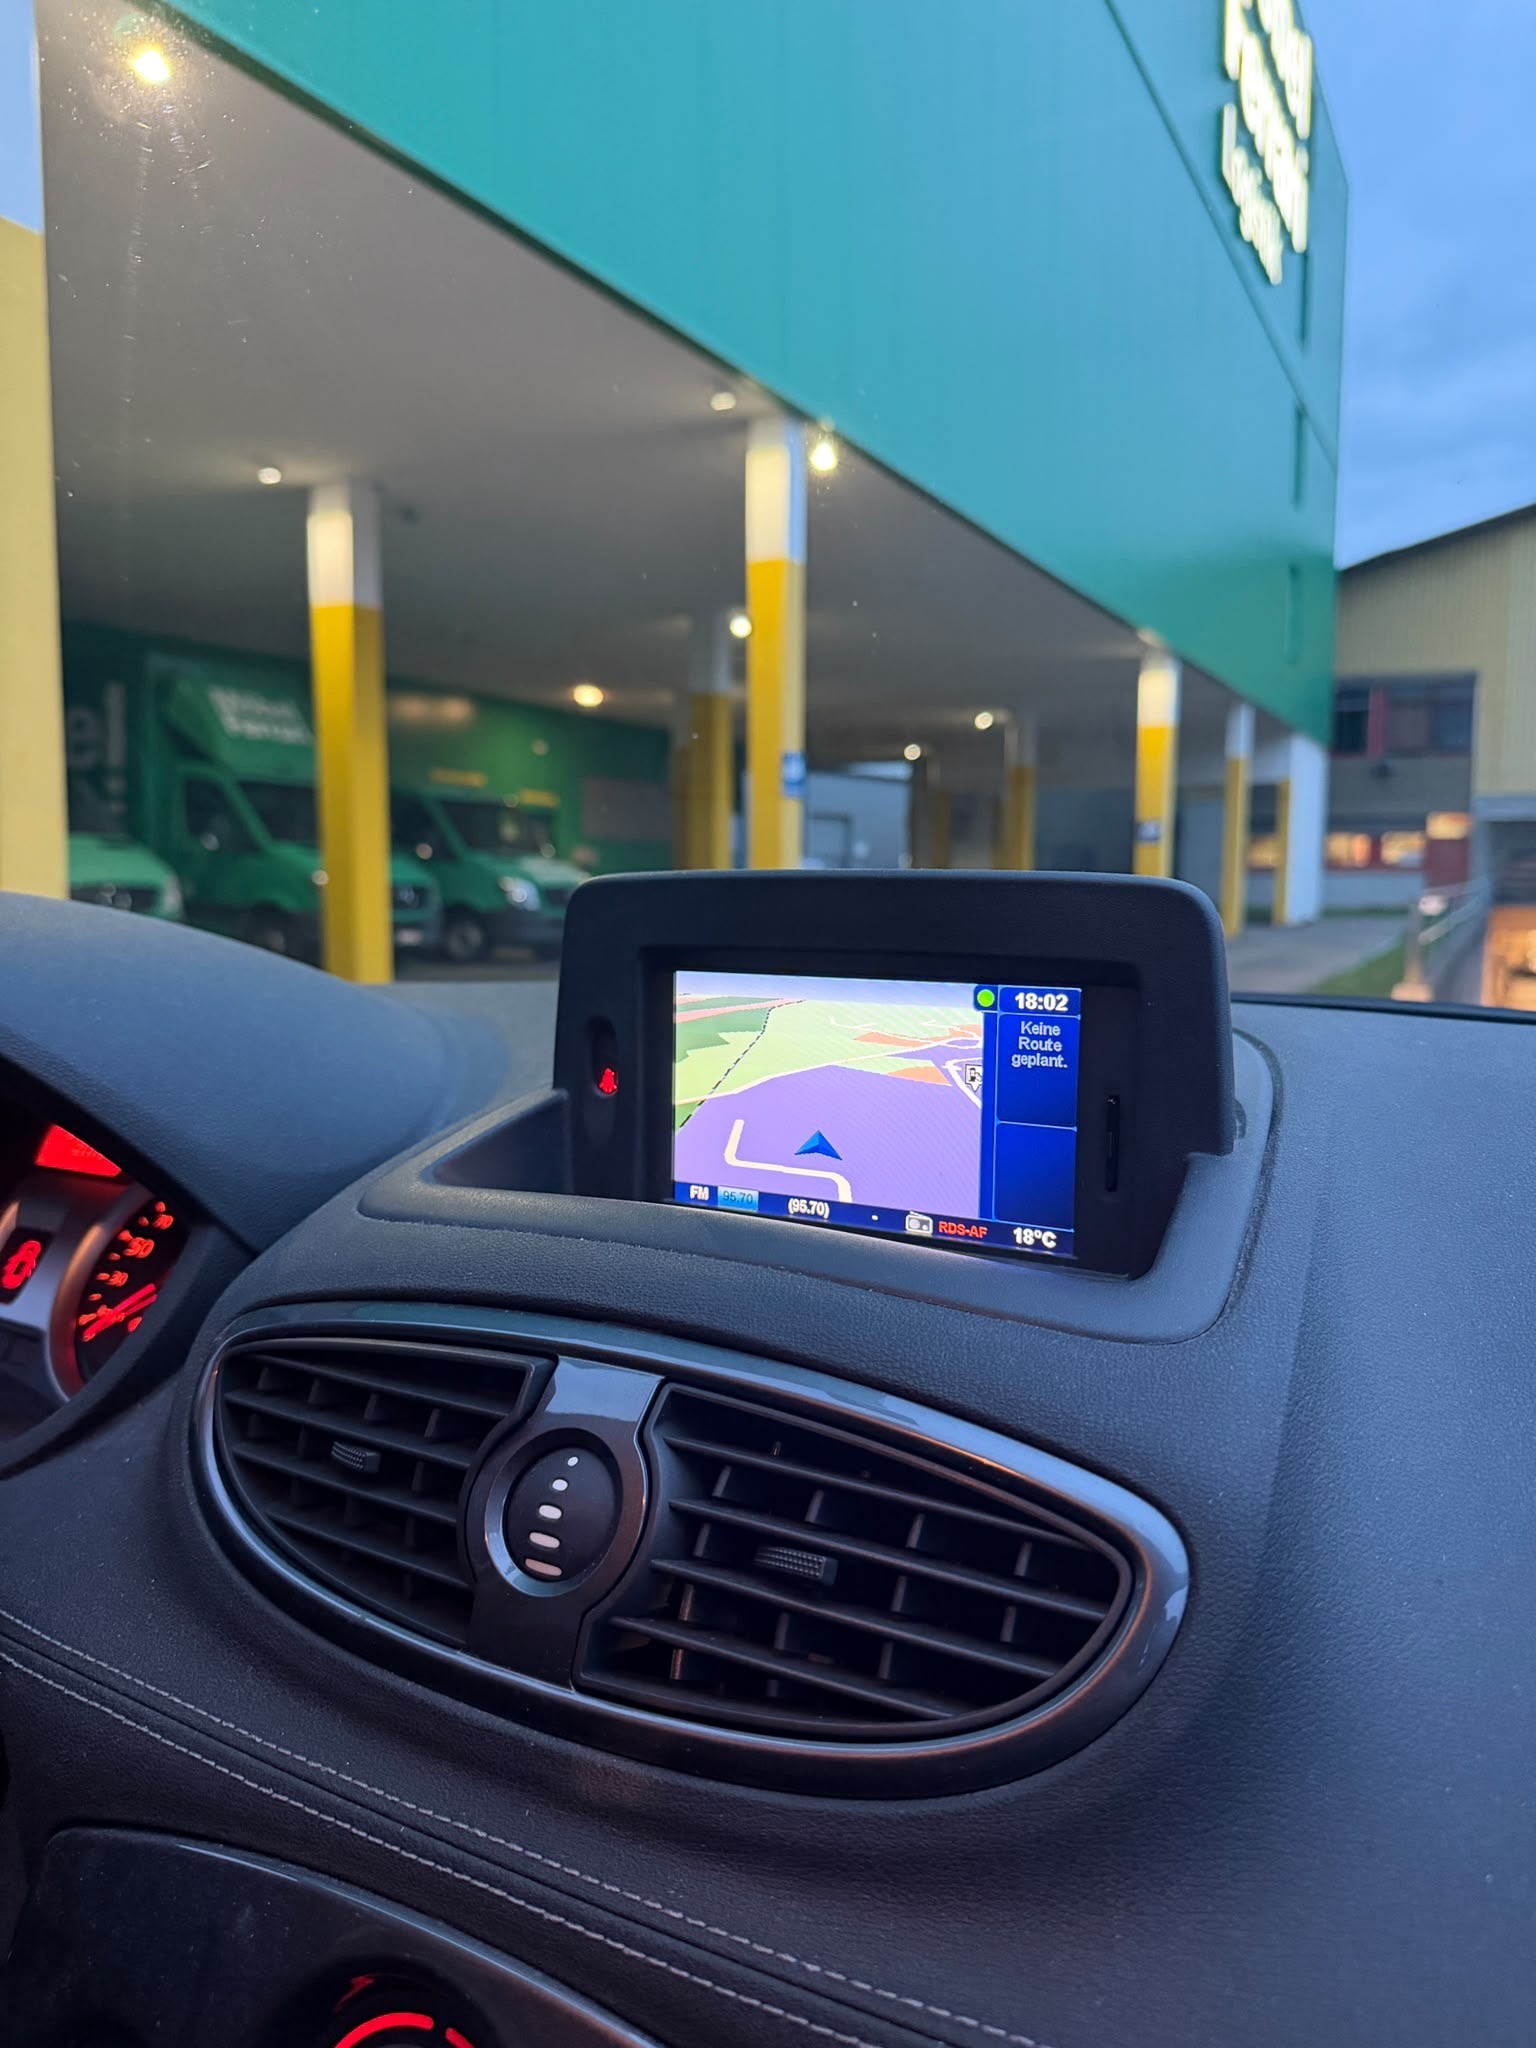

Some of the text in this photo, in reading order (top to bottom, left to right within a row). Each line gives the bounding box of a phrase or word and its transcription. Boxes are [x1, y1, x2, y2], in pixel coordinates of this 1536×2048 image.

[1015, 992, 1069, 1012] 18:02
[1020, 1021, 1061, 1036] Keine
[1018, 1036, 1062, 1052] Route
[1011, 1053, 1068, 1068] geplant.
[690, 1185, 709, 1201] FM
[723, 1190, 754, 1204] 95.70
[788, 1198, 830, 1219] (95.70)
[938, 1221, 988, 1238] RDS-AF
[123, 1236, 155, 1258] 50
